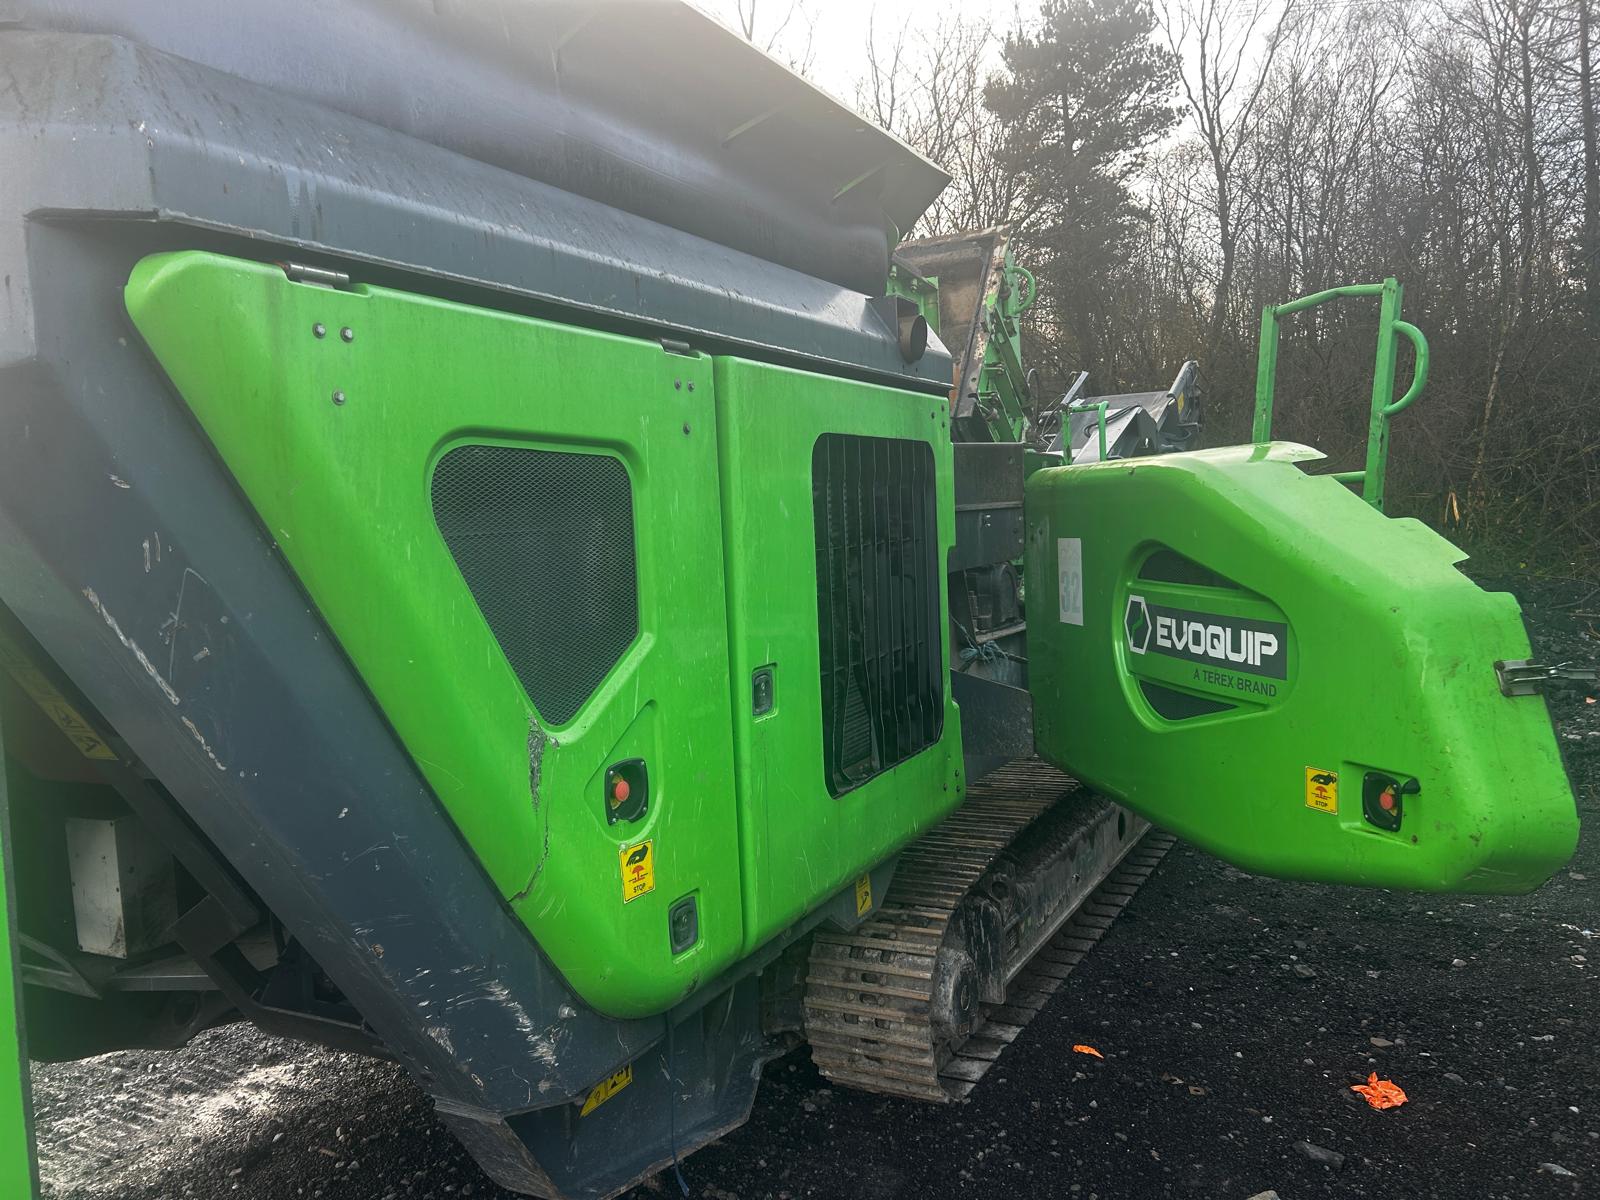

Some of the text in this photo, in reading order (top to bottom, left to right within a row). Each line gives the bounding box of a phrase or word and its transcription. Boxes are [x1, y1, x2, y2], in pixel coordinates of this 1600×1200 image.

[1156, 615, 1279, 667] EVOQUIP
[1193, 668, 1277, 697] A TEREX BRAND
[1315, 799, 1328, 808] STOP
[633, 882, 646, 893] STOP
